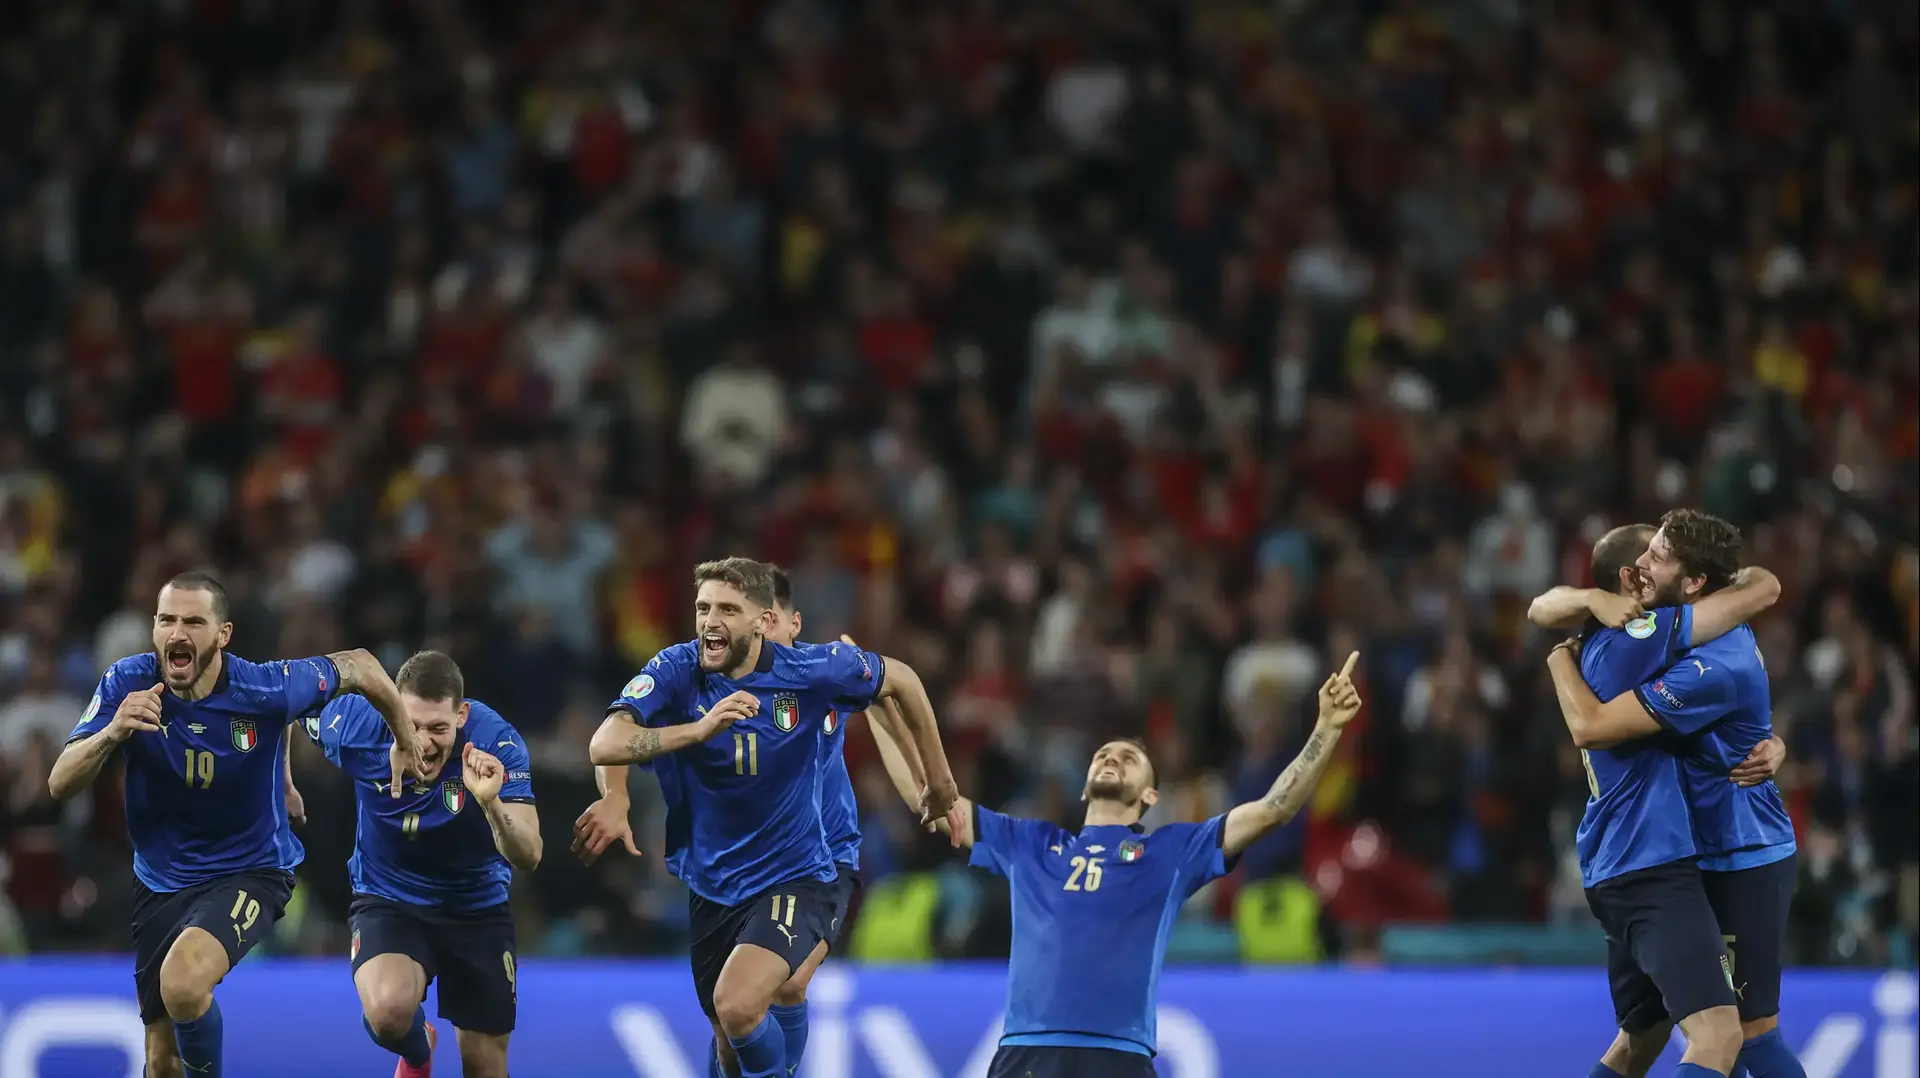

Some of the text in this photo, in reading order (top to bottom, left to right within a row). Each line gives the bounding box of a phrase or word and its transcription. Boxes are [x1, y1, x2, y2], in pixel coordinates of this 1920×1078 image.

[1660, 686, 1684, 709] RESPECT
[185, 749, 215, 790] 19
[733, 732, 758, 776] 11
[508, 771, 531, 780] RESPEC
[1063, 856, 1105, 892] 25
[230, 889, 261, 931] 19
[770, 894, 797, 928] 11
[503, 950, 516, 994] 9
